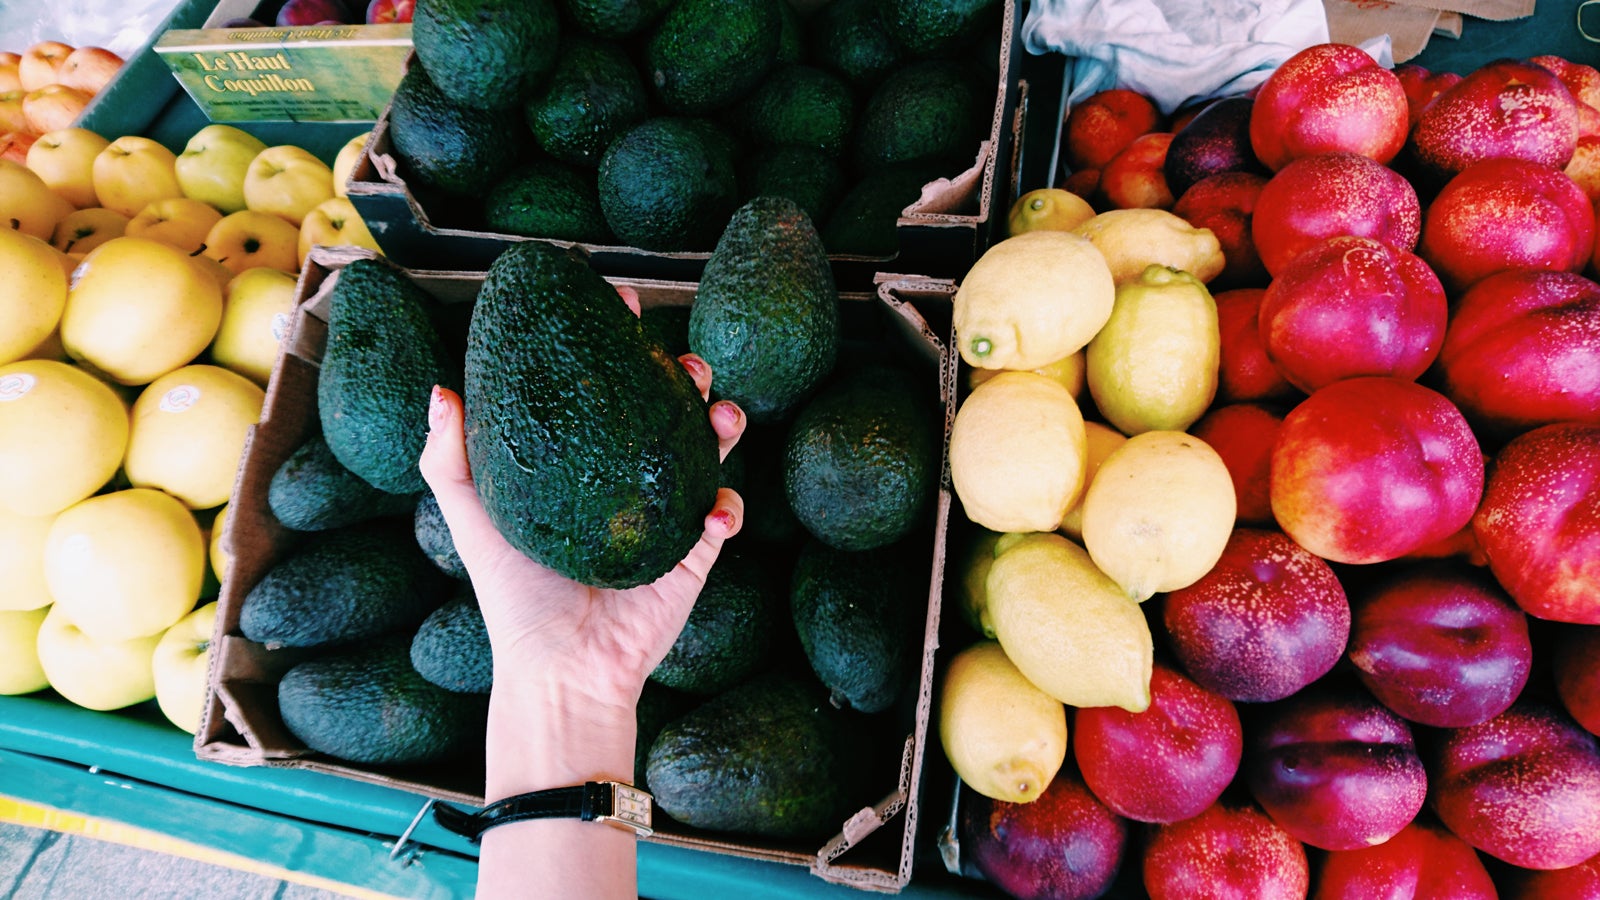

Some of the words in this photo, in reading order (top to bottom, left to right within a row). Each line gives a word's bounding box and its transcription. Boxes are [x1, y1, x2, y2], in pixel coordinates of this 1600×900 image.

[193, 53, 229, 71] Le
[225, 51, 291, 71] Haut
[204, 74, 315, 96] Coquillon
